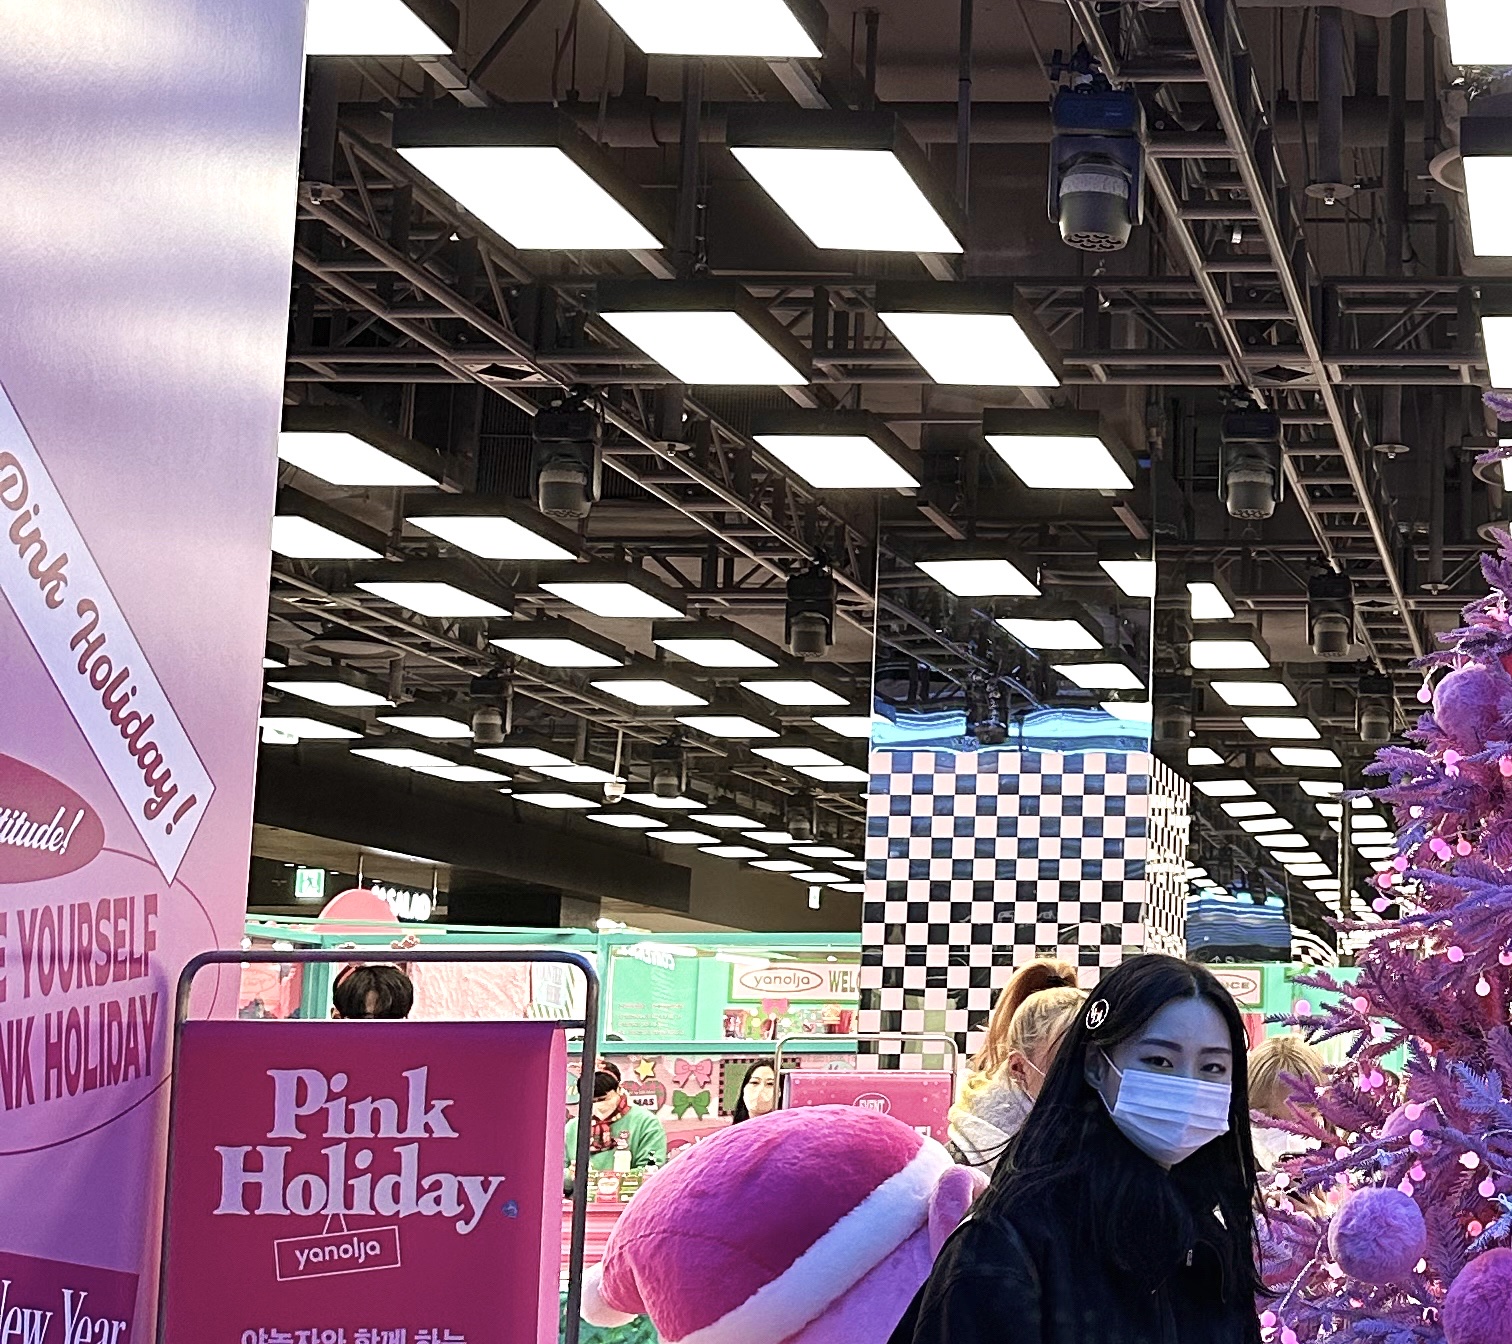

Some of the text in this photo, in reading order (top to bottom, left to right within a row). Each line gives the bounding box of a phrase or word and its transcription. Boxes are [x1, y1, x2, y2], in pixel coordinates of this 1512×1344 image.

[70, 598, 197, 835] Holiday!
[0, 806, 85, 855] titude!
[17, 894, 158, 998] YOURSELF
[754, 972, 811, 988] yanolja
[44, 992, 158, 1102] HOLIDAY
[266, 1066, 459, 1139] Pink
[213, 1143, 506, 1234] Holiday
[295, 1236, 381, 1270] yanolja
